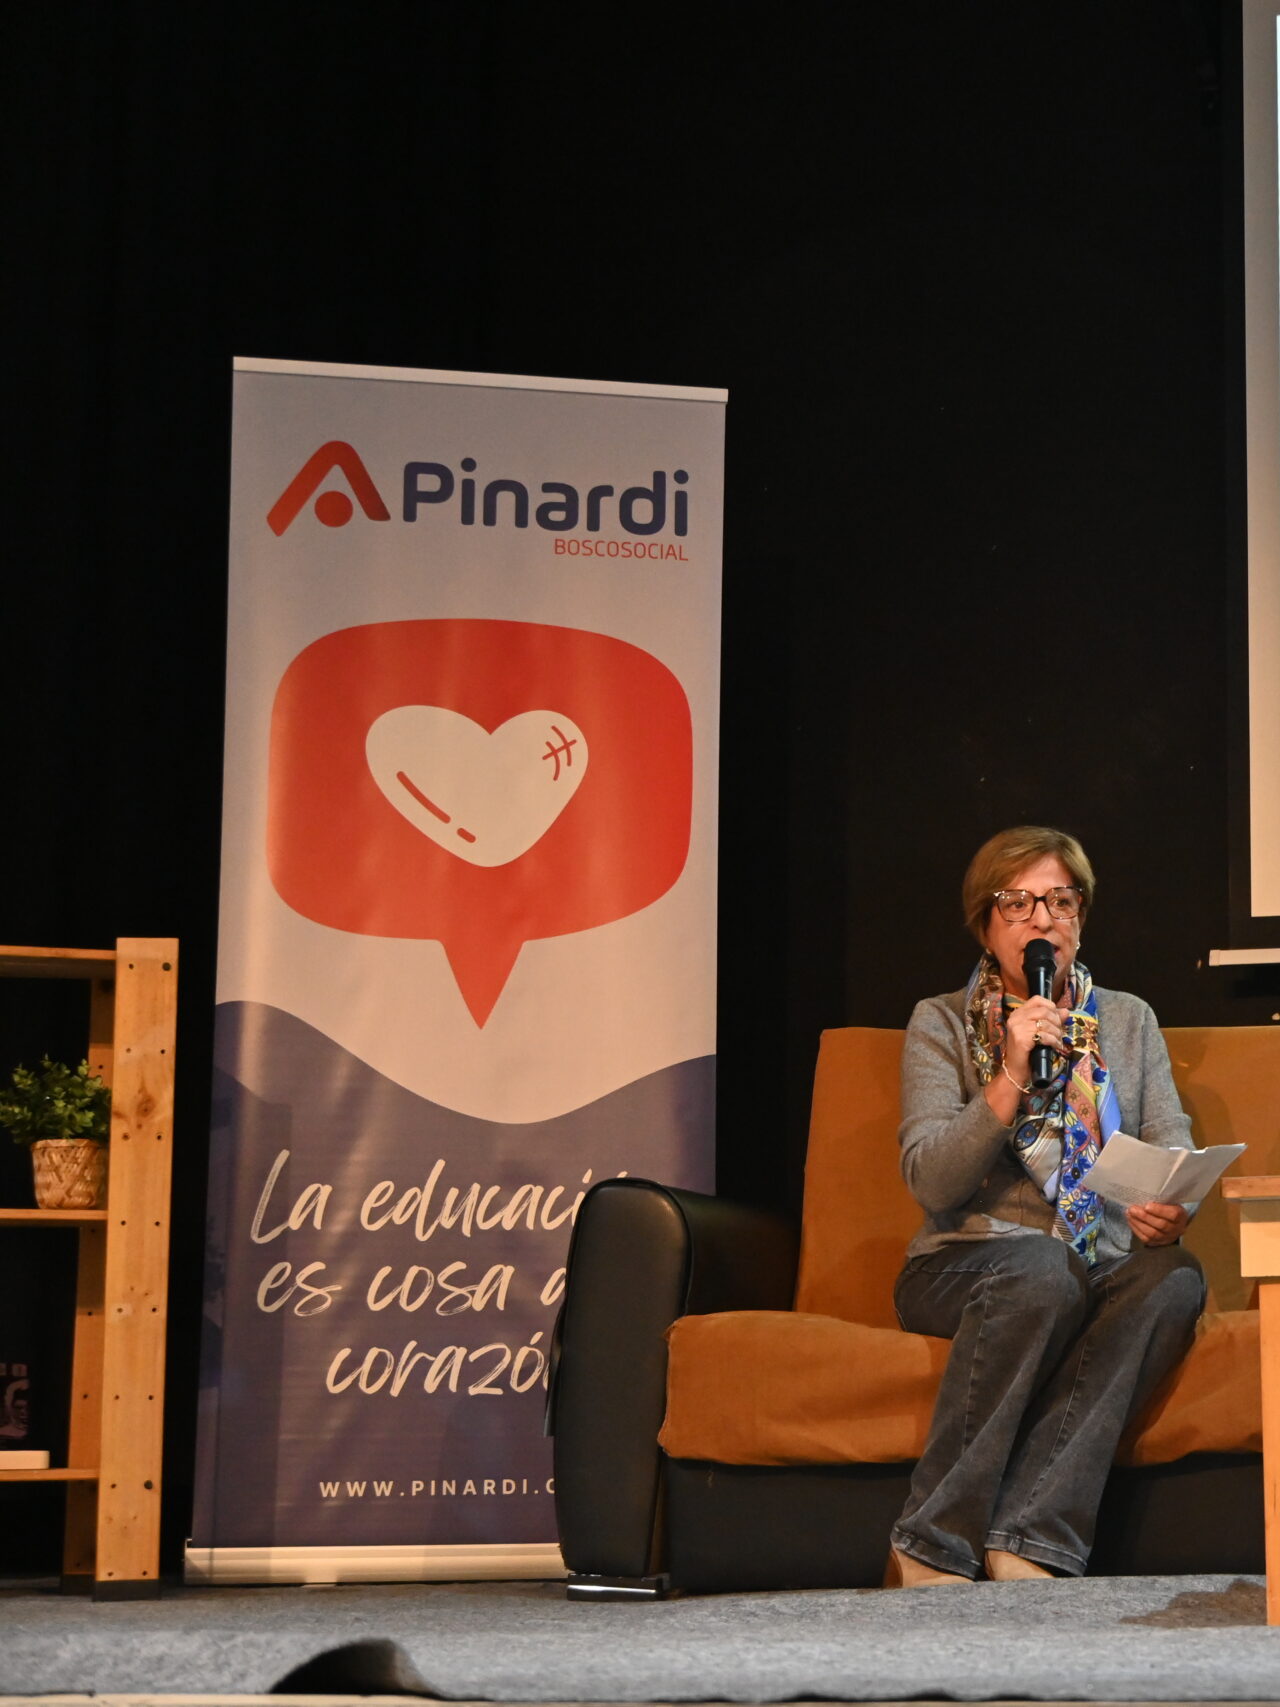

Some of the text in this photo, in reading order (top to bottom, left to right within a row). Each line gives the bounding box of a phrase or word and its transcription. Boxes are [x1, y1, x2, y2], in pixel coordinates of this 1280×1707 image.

[402, 457, 690, 536] Pinardi
[553, 538, 689, 562] BOSCOSOCIAL
[250, 1149, 628, 1244] La educaci
[257, 1261, 342, 1316] es
[367, 1260, 515, 1316] cosa
[325, 1332, 550, 1397] corazó
